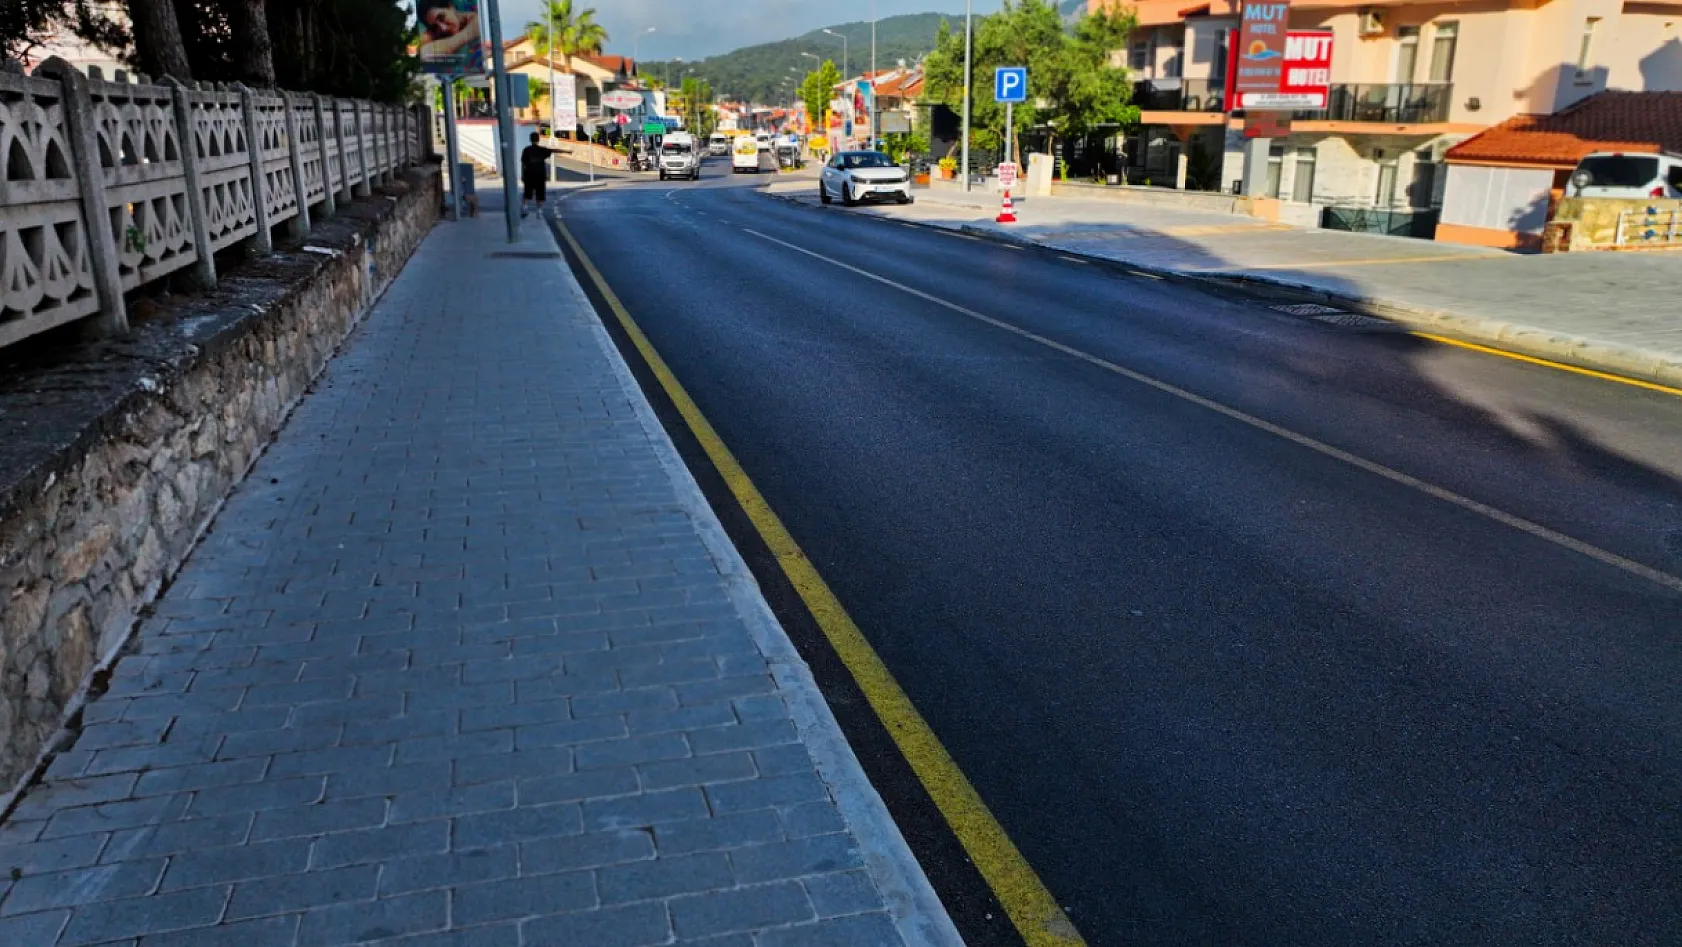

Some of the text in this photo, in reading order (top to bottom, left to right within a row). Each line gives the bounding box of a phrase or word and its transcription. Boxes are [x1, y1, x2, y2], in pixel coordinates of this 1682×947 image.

[1245, 3, 1287, 21] MUT
[1285, 36, 1333, 60] MUT
[1003, 72, 1019, 97] P
[1288, 68, 1331, 86] HOTEL
